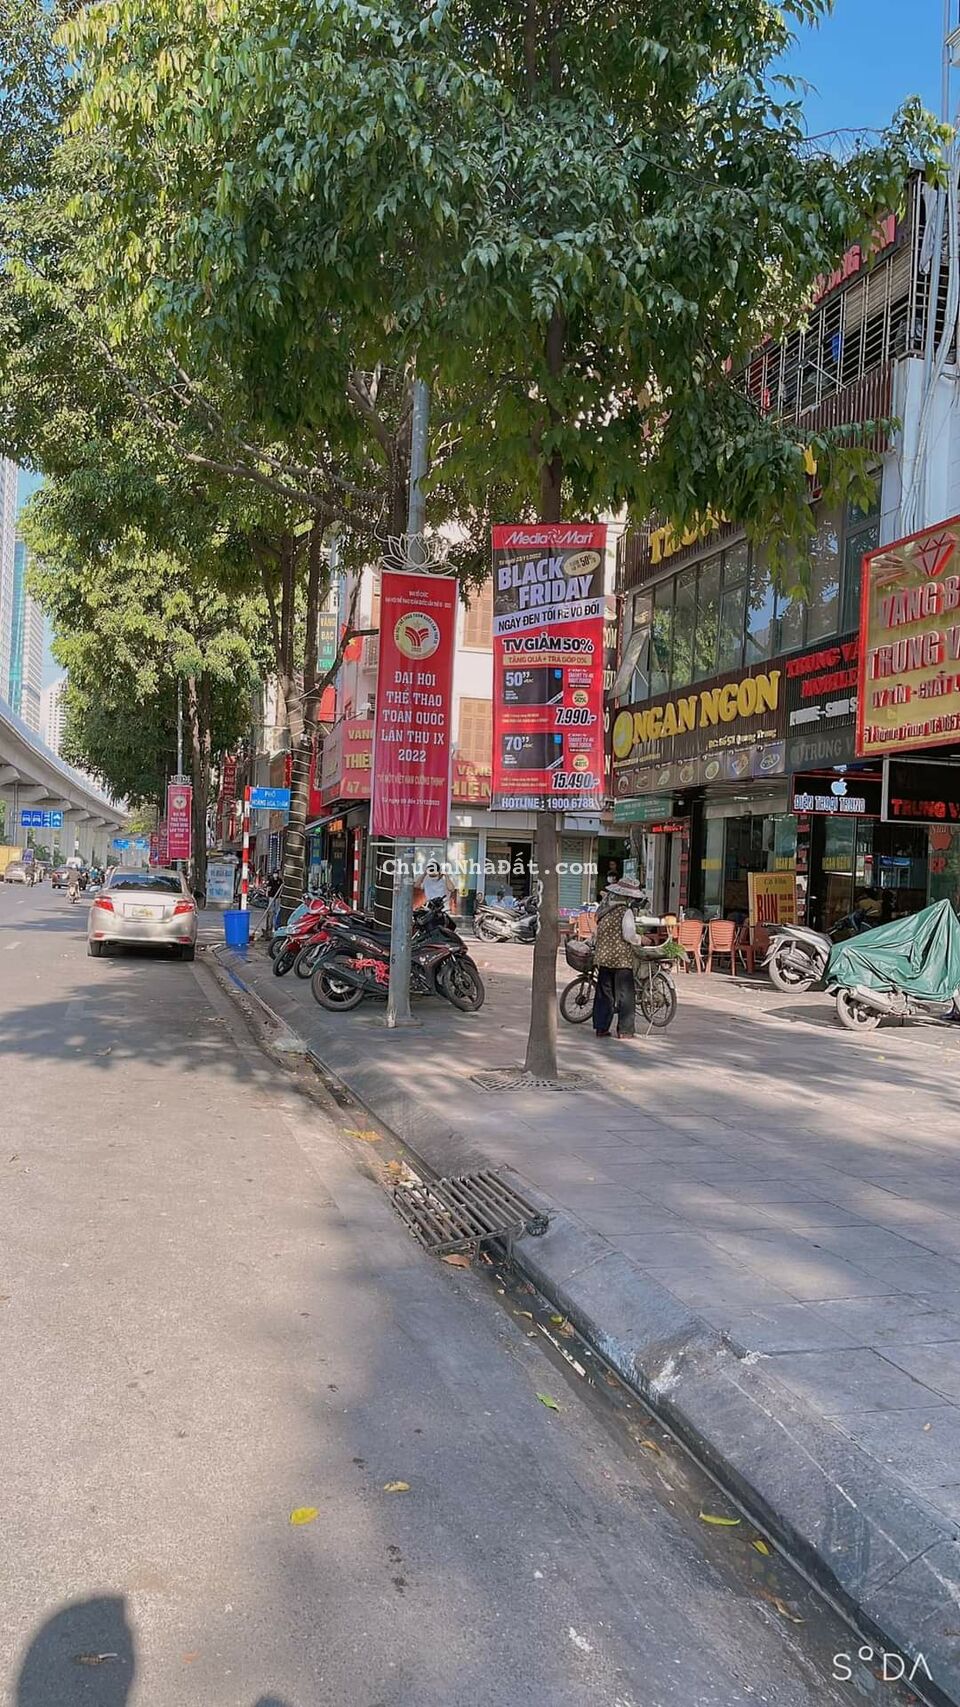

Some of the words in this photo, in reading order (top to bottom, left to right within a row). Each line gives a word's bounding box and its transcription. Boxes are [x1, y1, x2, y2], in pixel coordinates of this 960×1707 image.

[505, 531, 548, 545] Media
[557, 531, 594, 545] Mart
[498, 556, 564, 591] BLACK
[519, 574, 594, 609] FRIDAY
[944, 575, 960, 612] B
[498, 616, 521, 632] NGÀY
[522, 612, 540, 627] ĐEN
[542, 606, 556, 621] TỐI
[584, 600, 600, 615] ĐỐI
[503, 638, 523, 652] TV
[524, 632, 561, 652] GIẢM
[562, 638, 595, 653] 50%
[841, 634, 859, 662] V
[868, 630, 946, 680] TRUNG
[395, 671, 413, 687] ĐẠI
[417, 672, 436, 688] HỘI
[953, 675, 960, 692] L
[386, 689, 410, 705] THỂ
[413, 692, 442, 707] THAO
[633, 695, 698, 745] NGAN
[700, 670, 781, 728] NGON
[416, 710, 445, 726] QUỐC
[381, 727, 403, 742] LẦN
[434, 732, 445, 745] IX
[344, 750, 373, 772] THIỆ
[398, 749, 426, 763] 2022
[803, 740, 841, 763] TRUNG
[502, 797, 539, 809] HOTLINE
[891, 799, 946, 818] TRUNG
